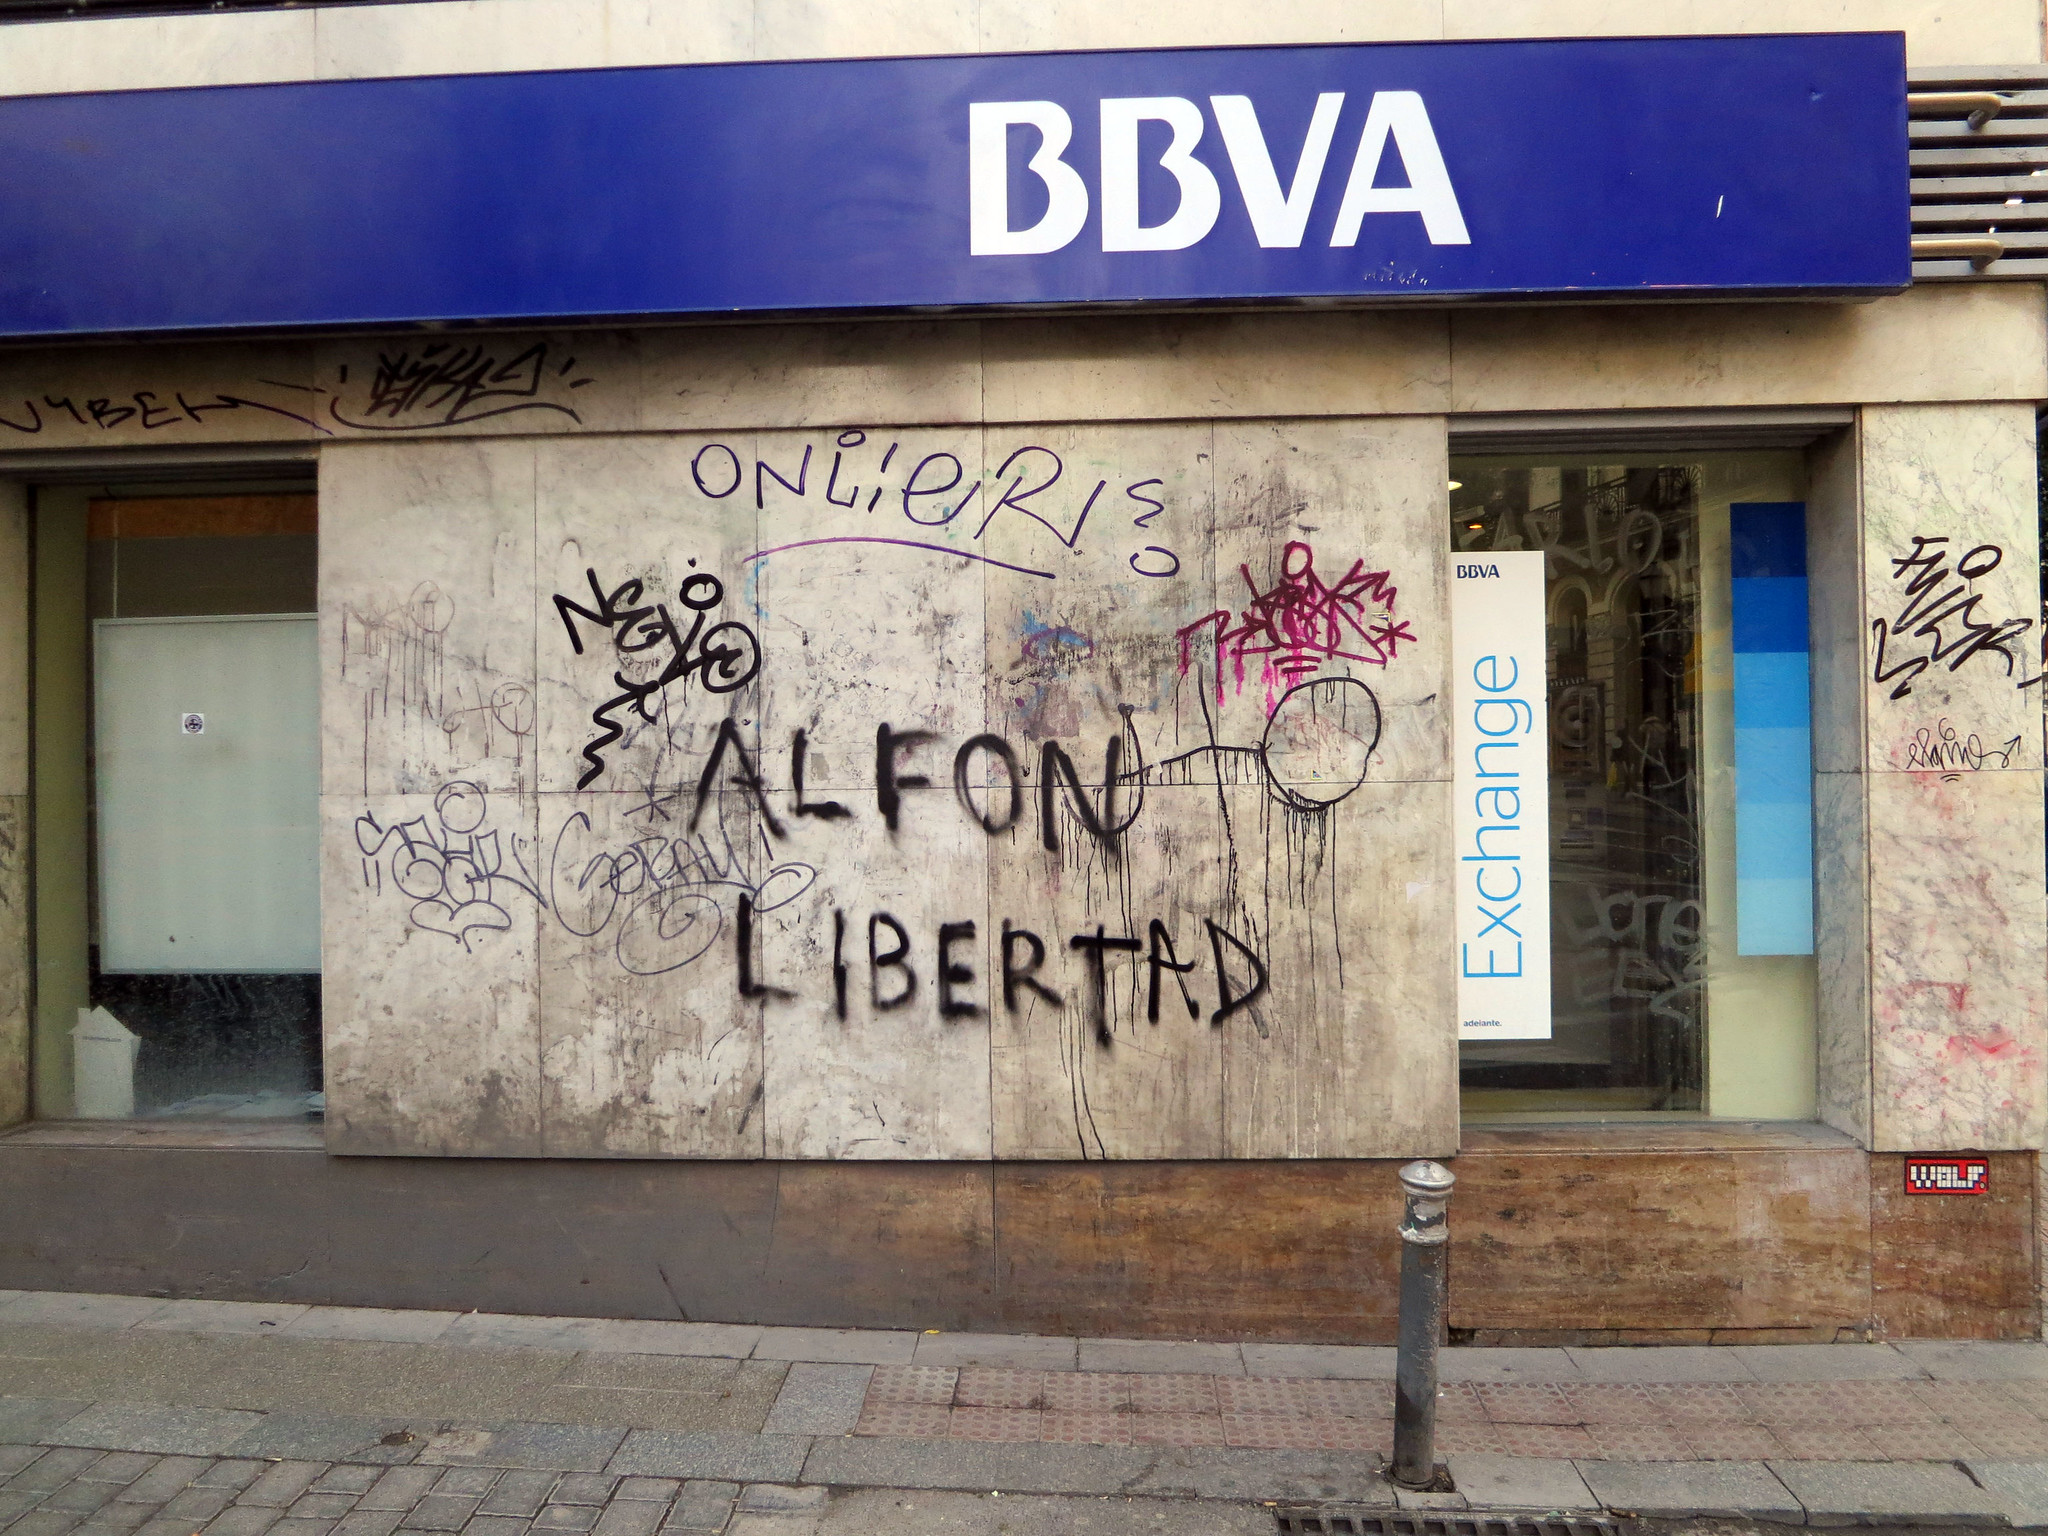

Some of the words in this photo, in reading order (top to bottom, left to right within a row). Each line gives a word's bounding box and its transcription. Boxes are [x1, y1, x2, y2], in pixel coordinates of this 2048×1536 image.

[968, 90, 1472, 257] BBVA
[1456, 564, 1500, 579] BBVA
[688, 717, 1123, 858] ALFON
[1461, 654, 1533, 979] Exchange
[736, 892, 1269, 1046] LIBERTAD
[1463, 1019, 1502, 1028] adelante.
